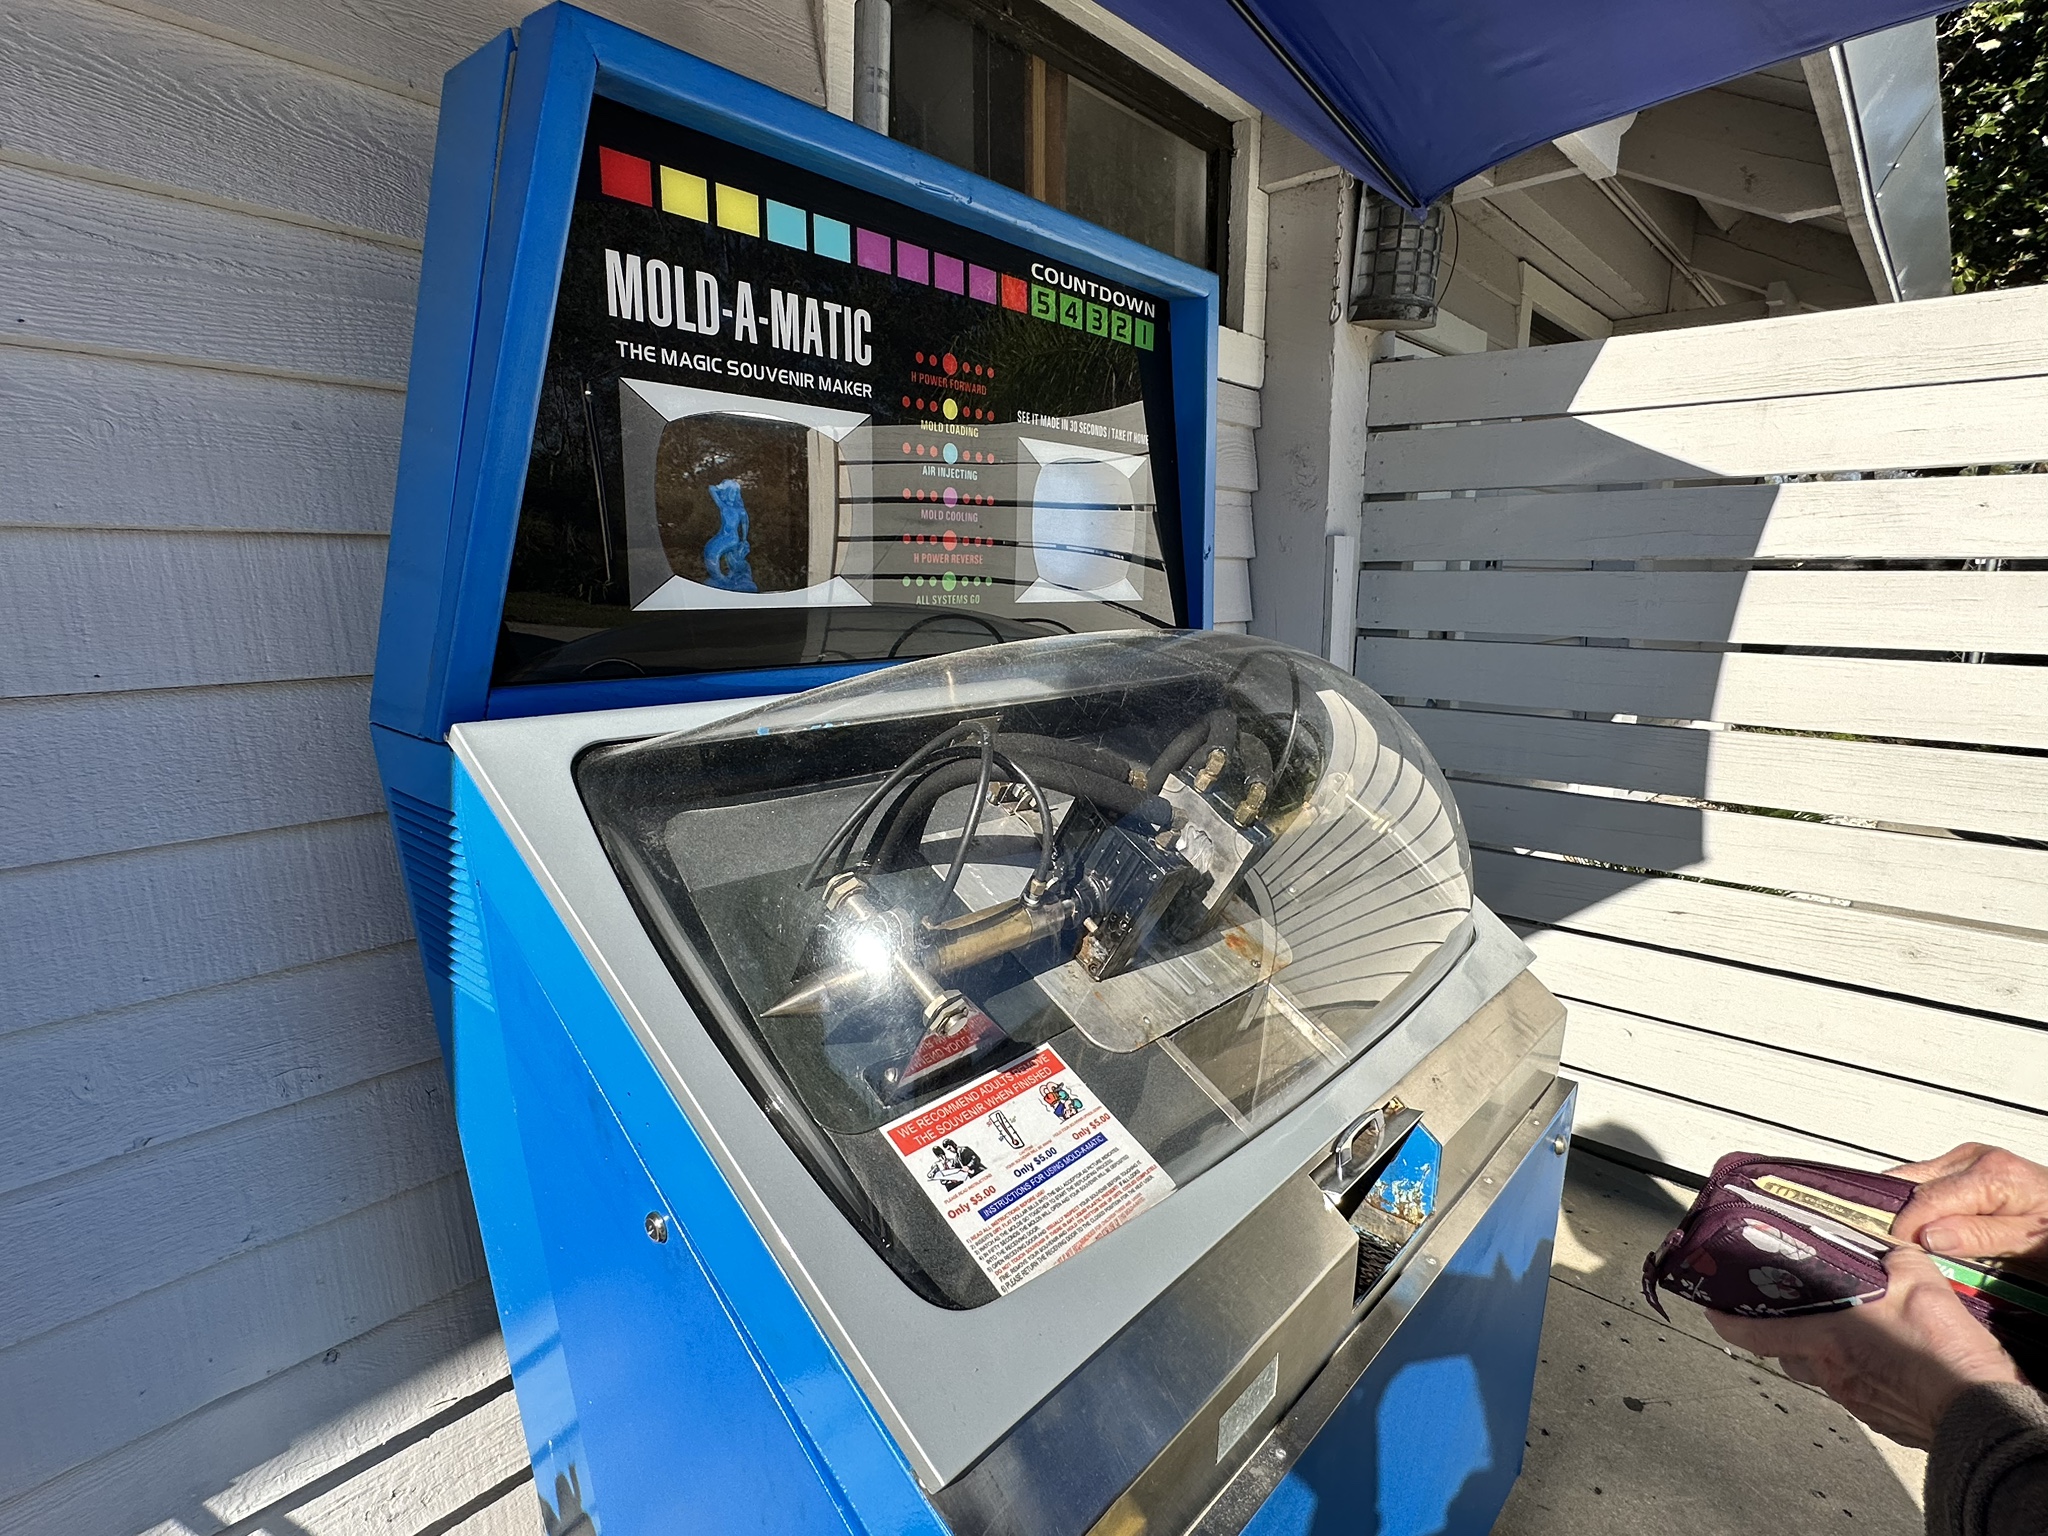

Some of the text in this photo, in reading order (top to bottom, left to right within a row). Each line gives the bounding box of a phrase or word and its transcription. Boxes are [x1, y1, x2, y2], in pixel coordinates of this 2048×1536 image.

[605, 248, 872, 367] MOLD-A-MATIC
[1031, 263, 1155, 318] COUNTDOWN
[1037, 291, 1050, 315] 5
[1065, 301, 1078, 323] 4
[1092, 308, 1103, 331] 3
[1116, 316, 1127, 339] 2
[615, 340, 872, 398] THE MAGIC SOUVENIR MAKER
[911, 371, 987, 395] H POWER FORWARD
[920, 420, 979, 438] MOLD LOADING
[1017, 410, 1030, 424] SEE
[1032, 413, 1040, 426] IT
[1040, 415, 1060, 430] MADE
[1062, 418, 1068, 430] IN
[1070, 420, 1078, 432] 30
[1079, 422, 1108, 438] SECONDS
[1112, 428, 1126, 441] TAKE
[1127, 431, 1133, 442] IT
[922, 466, 978, 480] AIR INJECTING
[921, 509, 978, 522] MOLD COOLING
[914, 553, 984, 564] H POWER REVERSE
[916, 594, 980, 604] ALL SYSTEMS GO
[897, 1123, 918, 1138] WE
[916, 1092, 979, 1128] RECOMMEND
[980, 1072, 1014, 1096] ADULTS
[1013, 1054, 1050, 1076] REMOVE
[913, 1129, 937, 1145] THE
[936, 1103, 986, 1134] SOUVENIR
[984, 1088, 1014, 1107] WHEN
[1012, 1067, 1052, 1092] FINISHED
[1072, 1122, 1091, 1141] Only
[1089, 1112, 1111, 1132] $5.00
[984, 1136, 1103, 1216] INSTRUCTIONS FOR USING MOLD-A-MATIC
[1013, 1146, 1057, 1178] Only $5.00
[948, 1185, 996, 1219] Only $5.00
[1008, 1220, 1023, 1232] MOLDS
[1028, 1202, 1050, 1217] TOGETHER
[1054, 1190, 1067, 1200] START
[1012, 1209, 1028, 1222] DOLLAR
[1027, 1201, 1039, 1211] BILLS
[1063, 1172, 1083, 1187] ACCEPTOR
[970, 1230, 983, 1241] READ
[991, 1206, 1020, 1227] INSTRUCTIONS
[1019, 1196, 1036, 1208] BEFORE
[988, 1244, 1000, 1254] FIFTY
[1000, 1231, 1020, 1246] SECONDS
[1027, 1216, 1042, 1227] MOLDS
[1050, 1202, 1062, 1212] OPEN
[1069, 1189, 1080, 1198] YOUR
[992, 1259, 1005, 1269] OPEN
[1004, 1243, 1026, 1260] RECEIVING
[1025, 1235, 1038, 1246] DOOR
[1046, 1216, 1064, 1231] VISUALLY
[1064, 1205, 1080, 1218] INSPECT
[1079, 1198, 1090, 1207] YOUR
[986, 1255, 997, 1264] INTO
[1005, 1234, 1028, 1251] RECEIVING
[1005, 1273, 1023, 1289] PLEASE
[1021, 1260, 1039, 1277] RETURN
[1036, 1254, 1047, 1263] THE
[1045, 1239, 1067, 1256] RECEIVING
[1065, 1230, 1078, 1242] DOOR
[1011, 1252, 1026, 1264] TOUCH
[1025, 1238, 1046, 1254] SOUVENIR
[1011, 1261, 1028, 1273] REMOVE
[1027, 1250, 1040, 1260] YOUR
[1039, 1236, 1059, 1252] SOUVENIR
